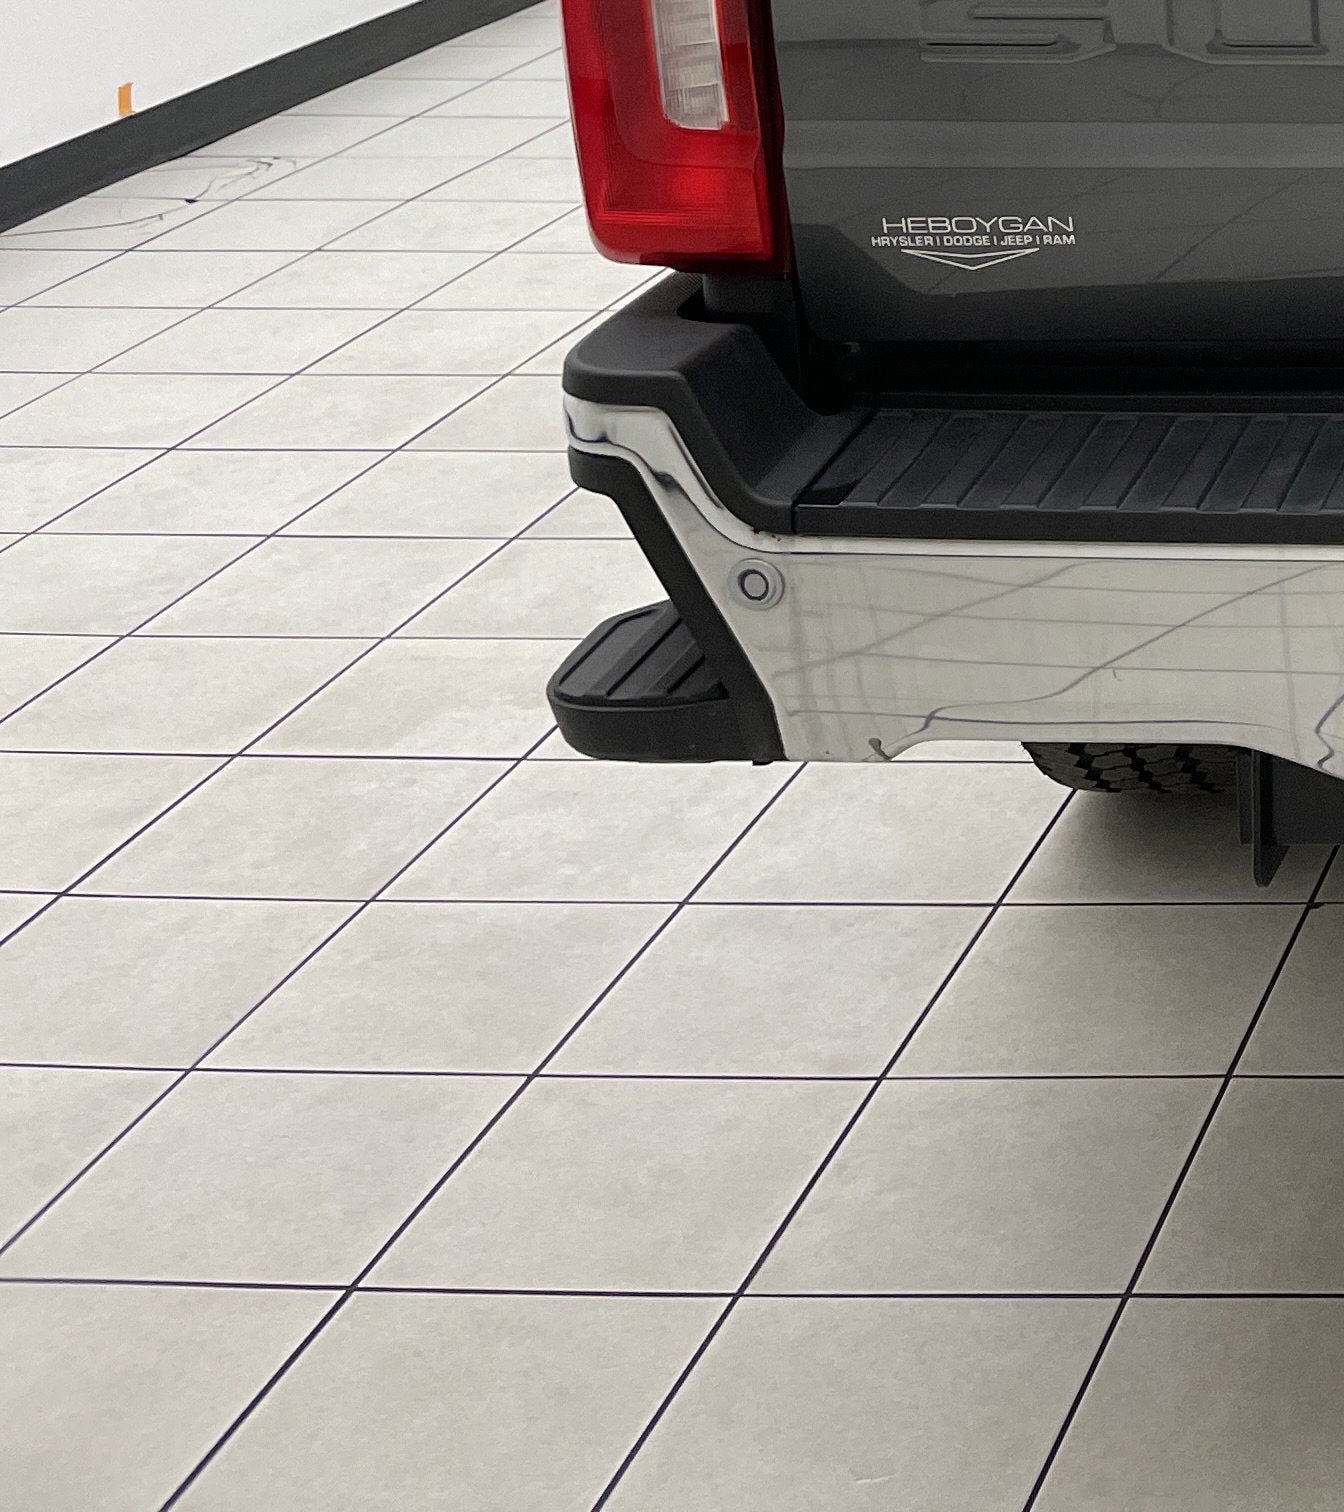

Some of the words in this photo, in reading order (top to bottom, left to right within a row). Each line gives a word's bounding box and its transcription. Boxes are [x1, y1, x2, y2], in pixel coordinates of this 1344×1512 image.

[882, 216, 1074, 233] HEBOYGAN
[944, 235, 991, 246] DODGE
[1000, 235, 1031, 246] JEEP
[1043, 234, 1075, 245] RAM
